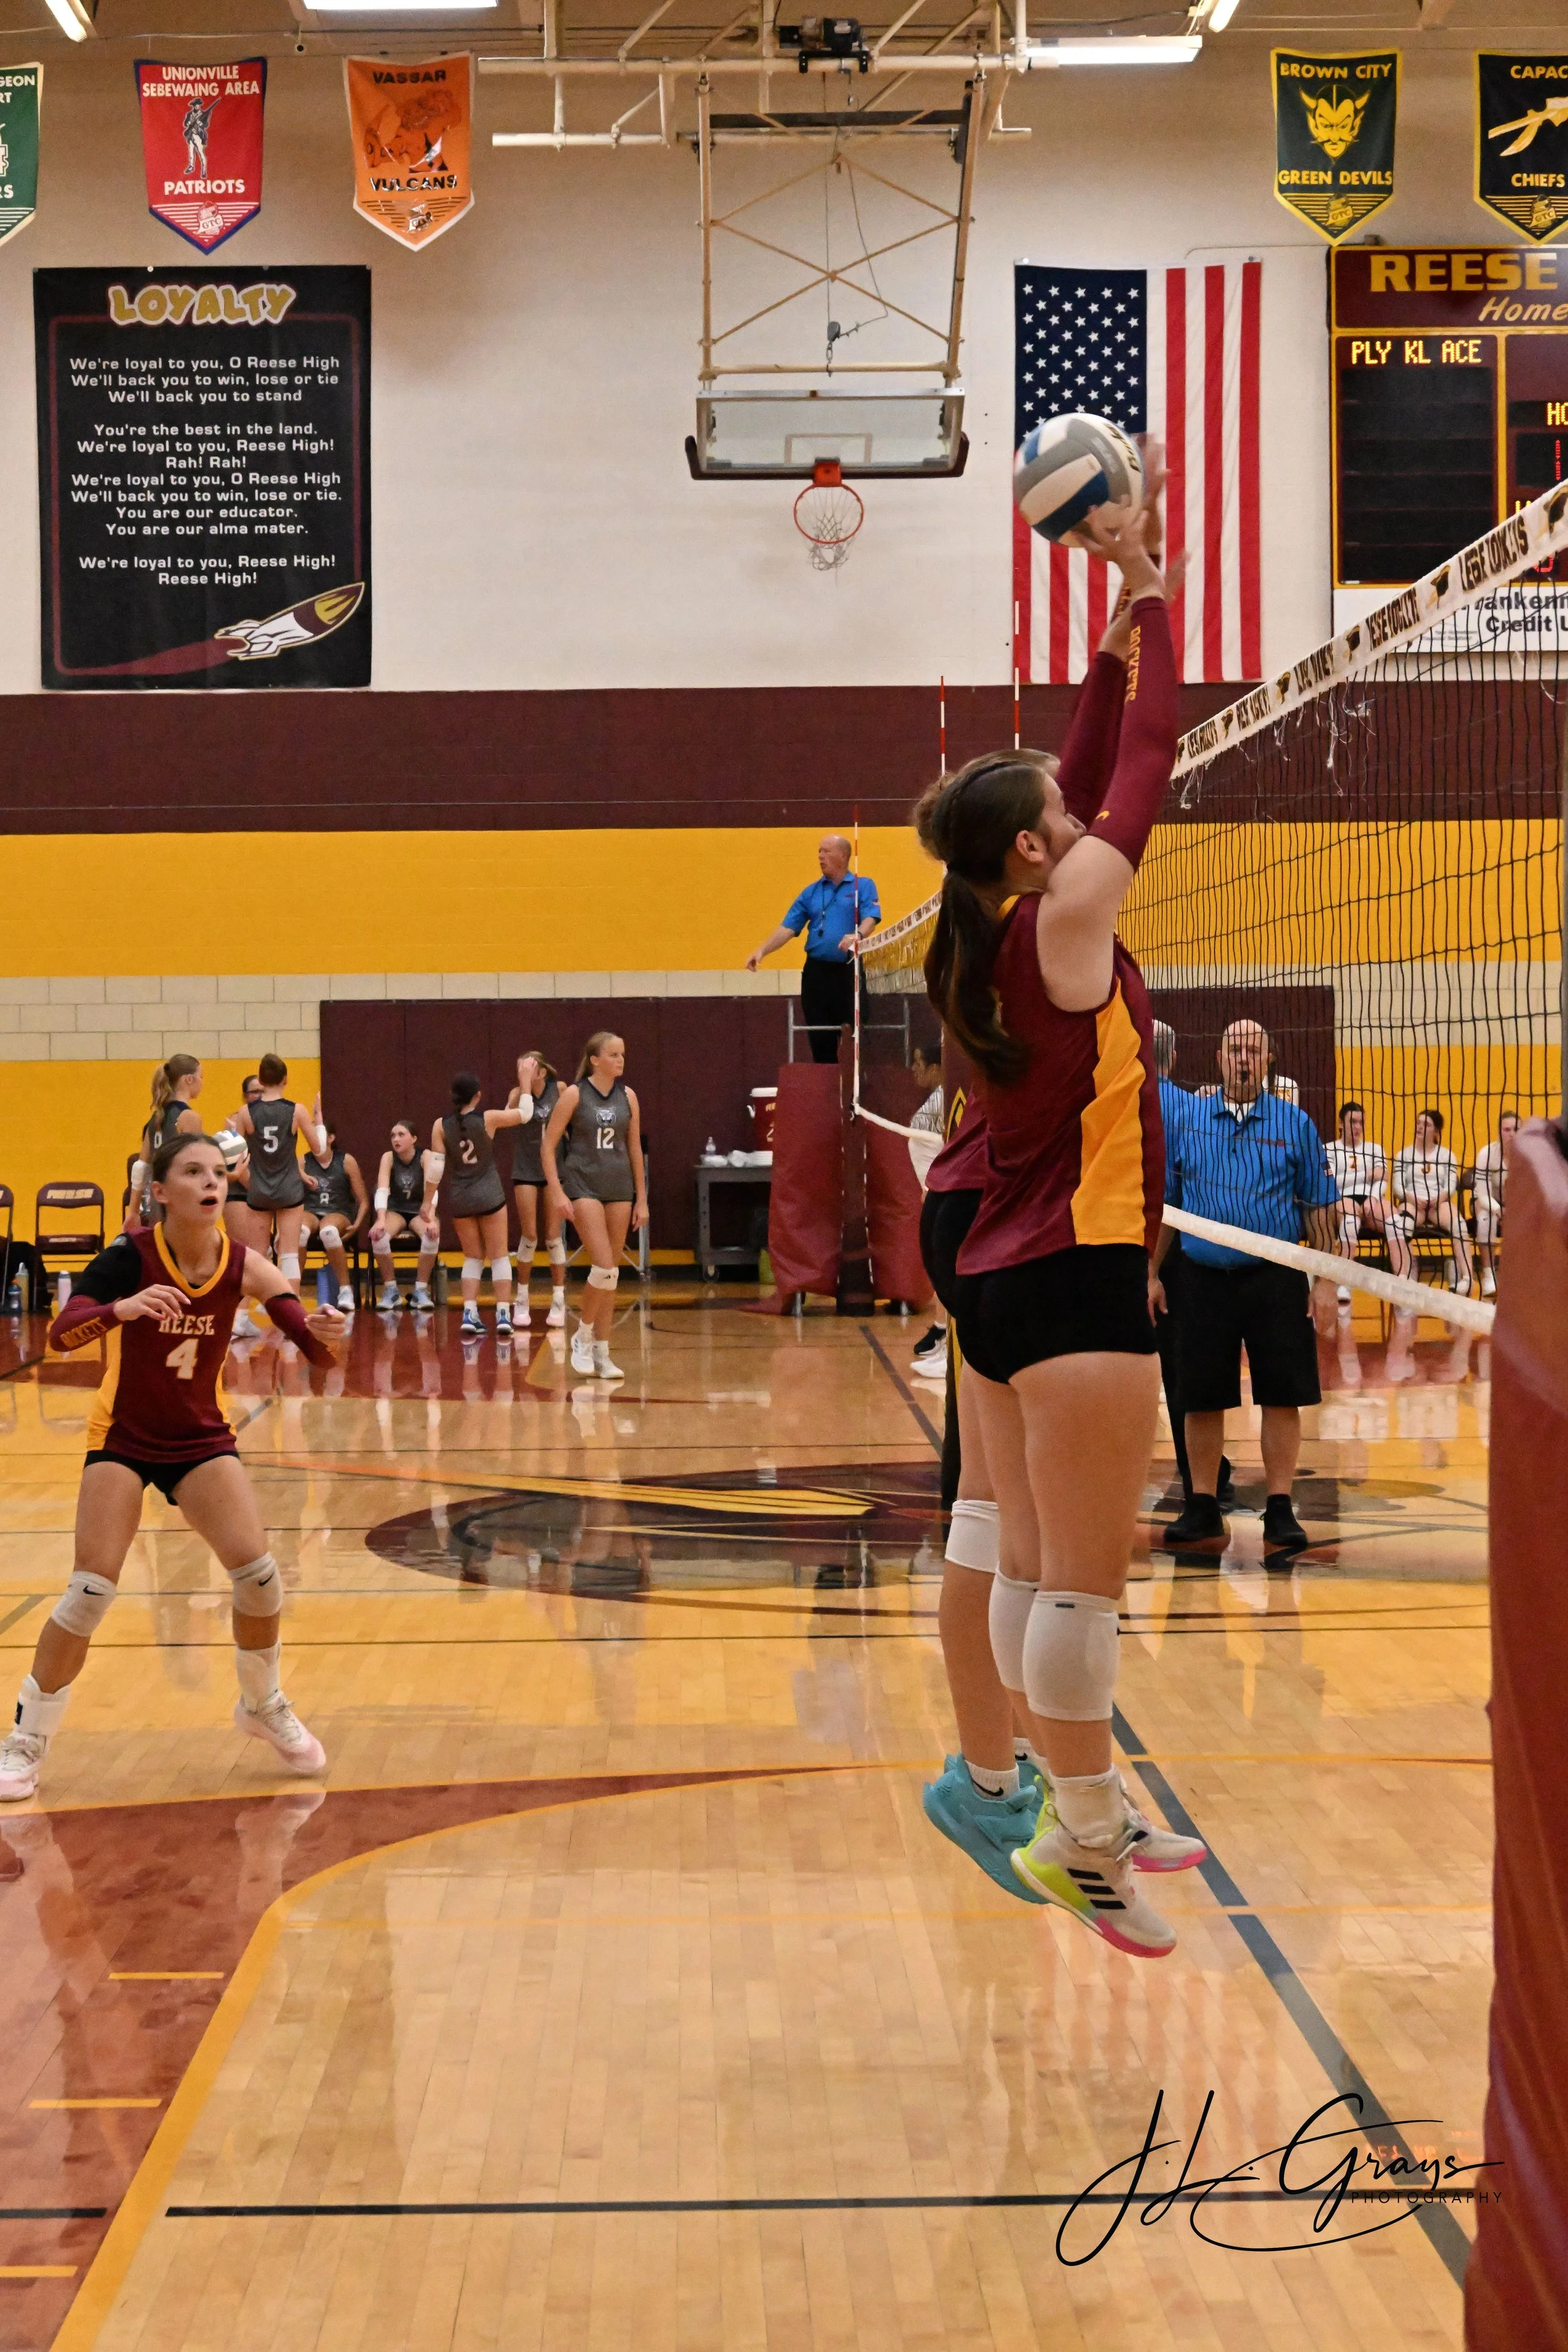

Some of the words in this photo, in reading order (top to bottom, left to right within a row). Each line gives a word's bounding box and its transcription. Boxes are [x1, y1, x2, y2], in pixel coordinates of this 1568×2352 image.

[162, 65, 239, 81] UNIONVILLE
[372, 70, 447, 84] VASSAR
[1280, 63, 1348, 79] BROWN
[1355, 63, 1392, 78] CITY
[1510, 65, 1568, 79] CAPAC
[142, 82, 219, 97] SEBEWAING
[225, 80, 260, 96] AREA
[369, 174, 458, 191] VULCANS
[1278, 170, 1332, 185] GREEN
[1339, 169, 1392, 186] DEVILS
[1511, 173, 1565, 188] CHIEFS
[164, 179, 245, 196] PATRIOTS
[202, 218, 221, 229] GTC
[1370, 252, 1558, 292] REESE
[108, 283, 297, 326] LOYALTY
[1478, 297, 1568, 322] Home
[1352, 340, 1391, 364] PLY
[1404, 340, 1431, 364] KL
[1441, 339, 1481, 364] ACE
[70, 358, 119, 370] We're
[125, 358, 162, 372] loyal
[168, 358, 185, 369] to
[191, 359, 223, 372] you,
[230, 356, 241, 368] O
[247, 356, 297, 368] Reese
[303, 356, 339, 371] High
[71, 374, 112, 386] We'll
[118, 374, 156, 386] back
[161, 376, 189, 389] you
[194, 374, 212, 385] to
[217, 373, 249, 386] win,
[255, 373, 289, 385] lose
[294, 376, 312, 384] or
[317, 373, 339, 384] tie
[108, 390, 149, 403] We'll
[156, 390, 194, 403] back
[199, 393, 227, 405] you
[233, 391, 250, 401] to
[256, 389, 302, 401] stand
[94, 423, 146, 436] You're
[152, 423, 179, 436] the
[185, 423, 221, 435] best
[226, 423, 241, 435] in
[246, 423, 273, 435] the
[279, 422, 317, 435] land.
[77, 440, 127, 453] We're
[132, 440, 169, 455] loyal
[175, 441, 192, 452] to
[198, 442, 230, 455] you,
[236, 439, 286, 452] Reese
[292, 438, 334, 454] High!
[166, 456, 203, 469] Rah!
[209, 455, 246, 469] Rah!
[72, 474, 121, 486] We're
[127, 473, 164, 489] loyal
[169, 474, 187, 485] to
[193, 475, 225, 488] you,
[231, 472, 243, 485] O
[248, 472, 298, 484] Reese
[304, 472, 341, 487] High
[71, 490, 112, 502] We'll
[118, 490, 156, 502] back
[161, 492, 189, 505] you
[194, 491, 211, 502] to
[216, 489, 248, 502] win,
[255, 489, 287, 501] lose
[293, 492, 311, 501] or
[315, 489, 342, 501] tie.
[116, 506, 146, 519] You
[152, 509, 180, 519] are
[186, 509, 213, 518] our
[219, 506, 298, 518] educator.
[105, 523, 136, 536] You
[142, 526, 169, 535] are
[176, 526, 203, 535] our
[209, 522, 248, 534] alma
[255, 523, 309, 534] mater.
[79, 556, 128, 569] We're
[134, 556, 171, 571] loyal
[177, 558, 194, 568] to
[199, 558, 232, 571] you,
[238, 555, 287, 568] Reese
[294, 554, 335, 570] High!
[158, 573, 208, 585] Reese
[215, 571, 257, 587] High!
[1486, 615, 1552, 632] Credit
[263, 1126, 278, 1153] 5
[596, 1127, 615, 1150] 12
[459, 1140, 477, 1164] 2
[166, 1338, 199, 1380] 4
